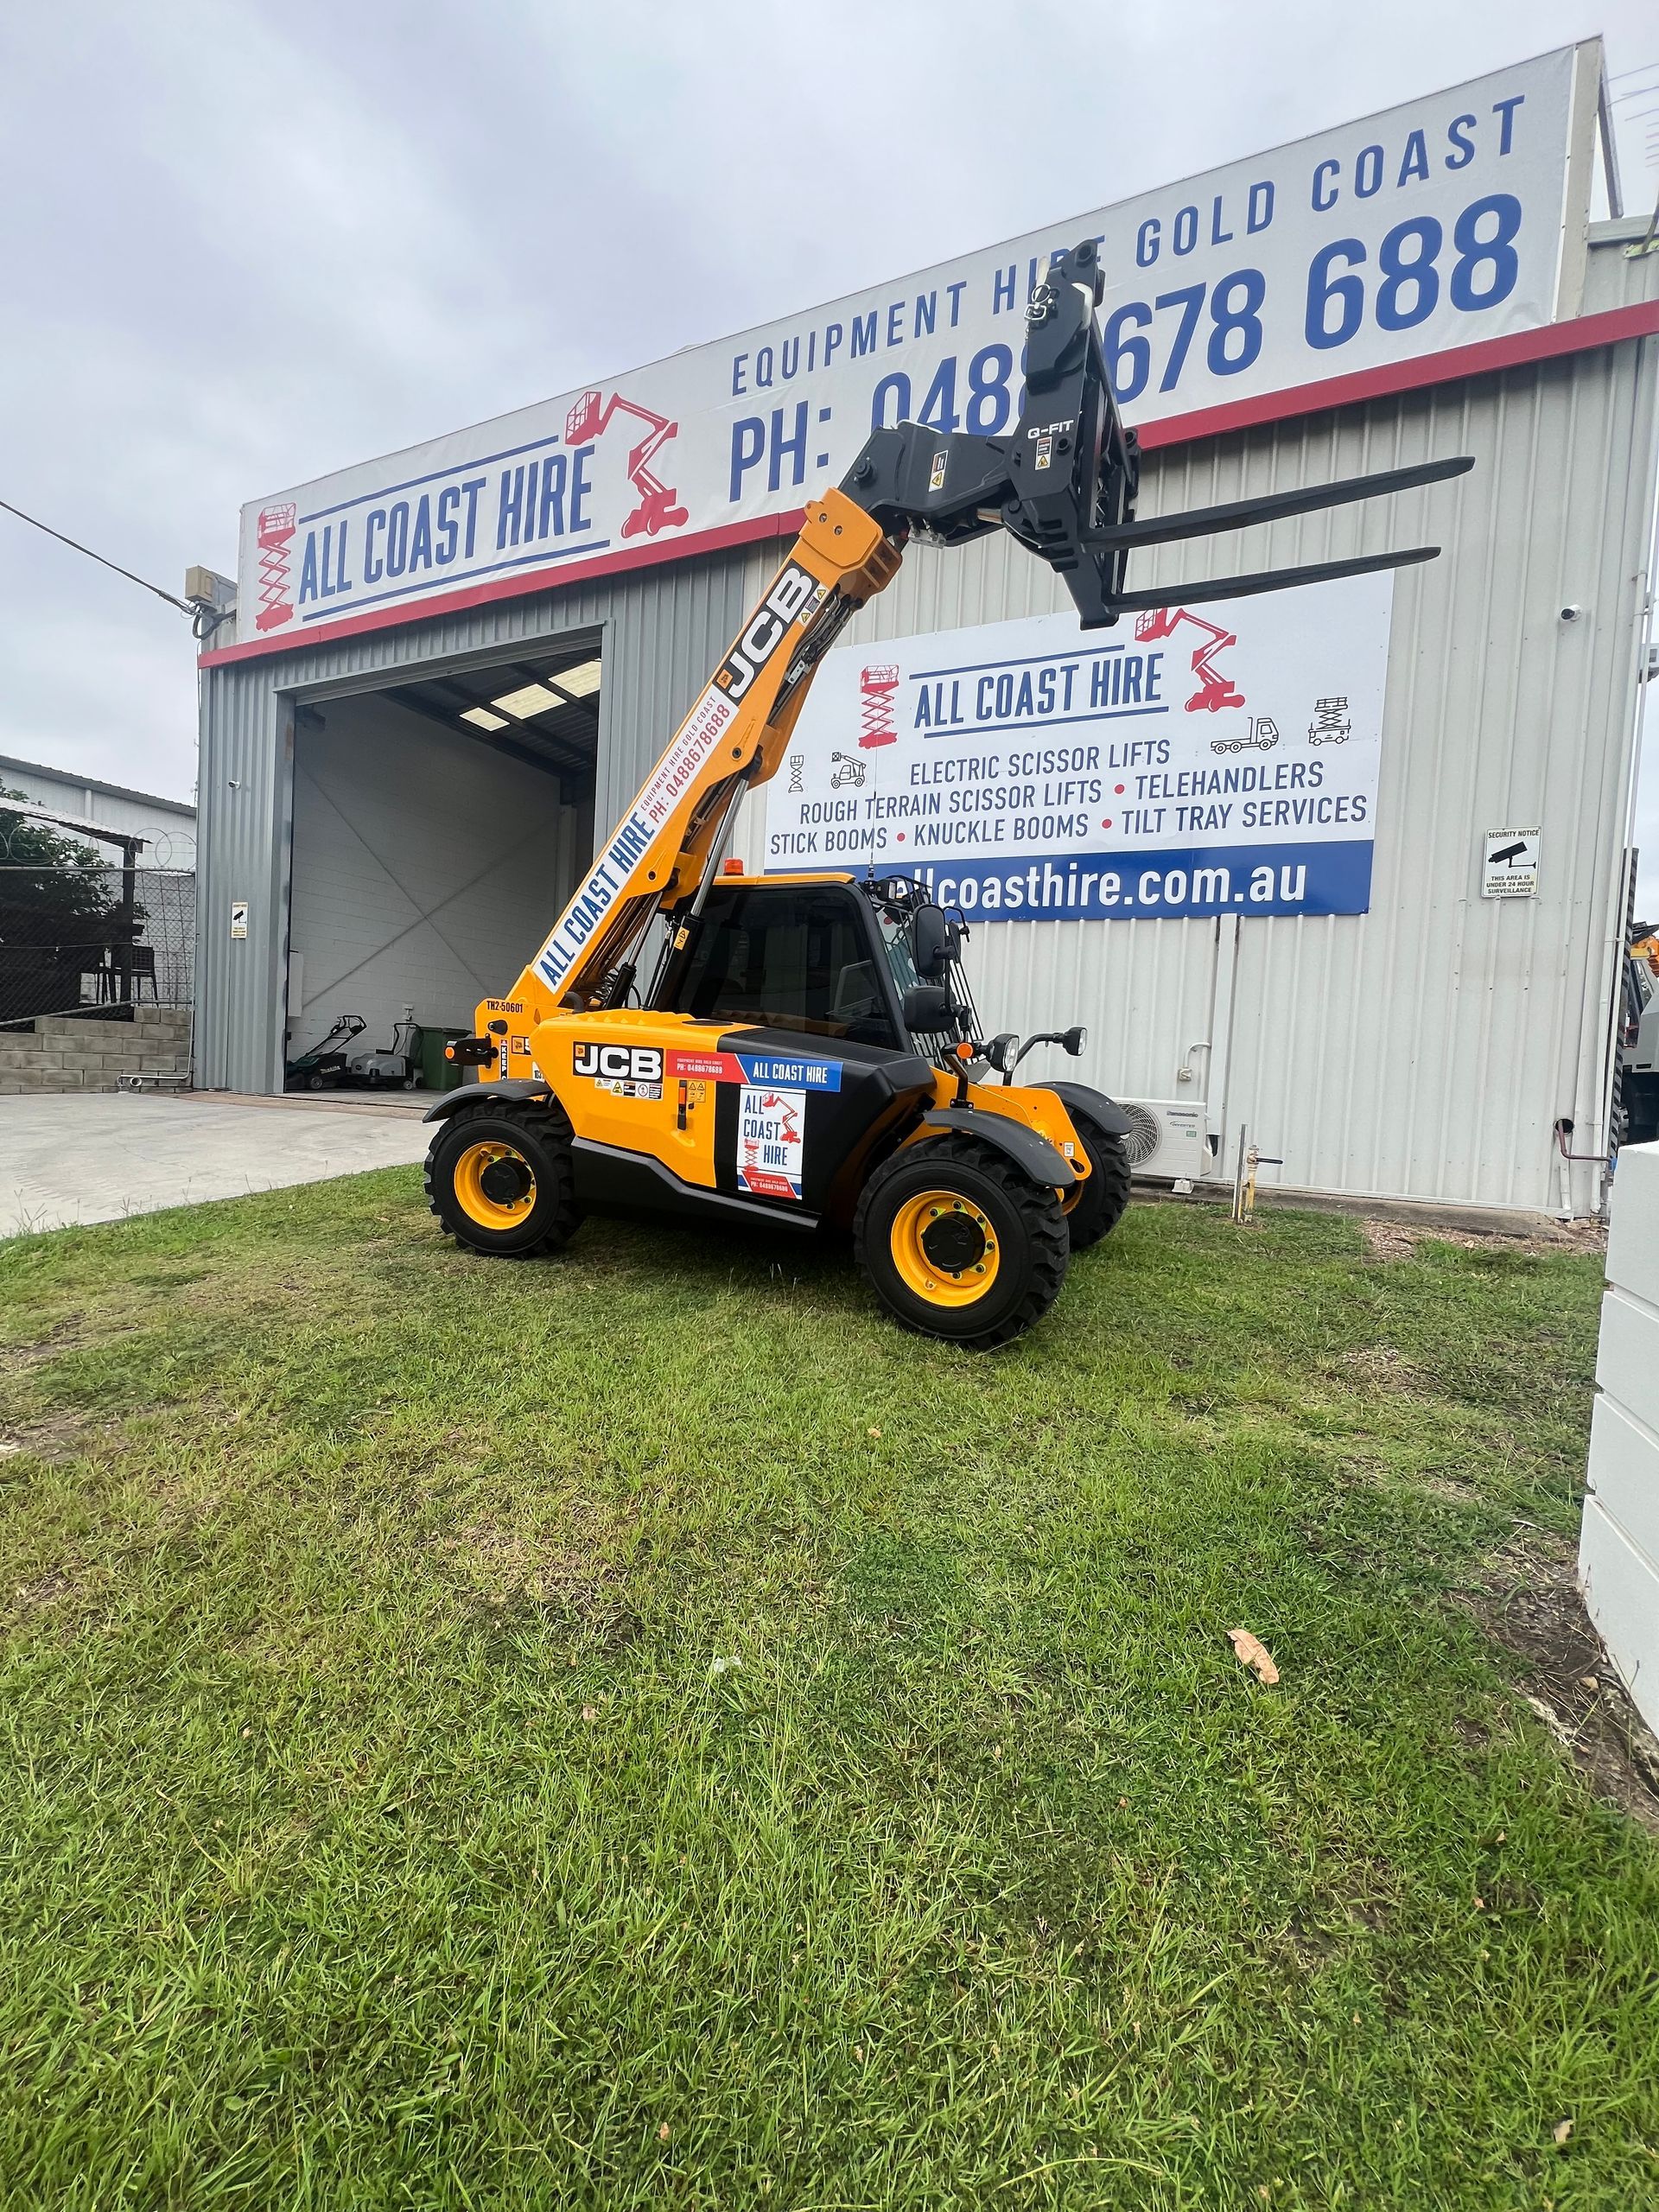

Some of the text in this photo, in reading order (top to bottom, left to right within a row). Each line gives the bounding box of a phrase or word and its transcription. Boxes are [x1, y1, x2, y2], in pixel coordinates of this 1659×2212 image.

[732, 94, 1526, 397] EQUIPMENT HI GOLD COAST
[729, 193, 1523, 503] PH: 048 678 688
[1027, 419, 1074, 439] Q-FIT
[298, 445, 595, 604] ALL COAST HIRE
[728, 567, 814, 698] JCB
[913, 652, 1164, 728] ALL COAST HIRE
[640, 696, 716, 812] EQUIPMENT HIRE GOLD COAST
[648, 703, 730, 823] PH: 0488678688
[910, 739, 1171, 786] ELECTRIC SCISSOR LIFTS
[800, 761, 1324, 825] ROUGH TERRAIN SCISSOR LIFTS TELEHANDLERS
[770, 795, 1368, 855] STICK BOOMS KNUCKLE BOOMS TILT TRAY SERVICES
[539, 812, 656, 986] ALL COAST HIRE
[486, 1001, 523, 1013] TH2-50601
[575, 1046, 662, 1081] JCB
[753, 1062, 828, 1084] ALL COAST HIRE
[743, 1119, 781, 1141] COAST
[744, 1094, 765, 1115] ALL
[763, 1145, 788, 1166] HIRE
